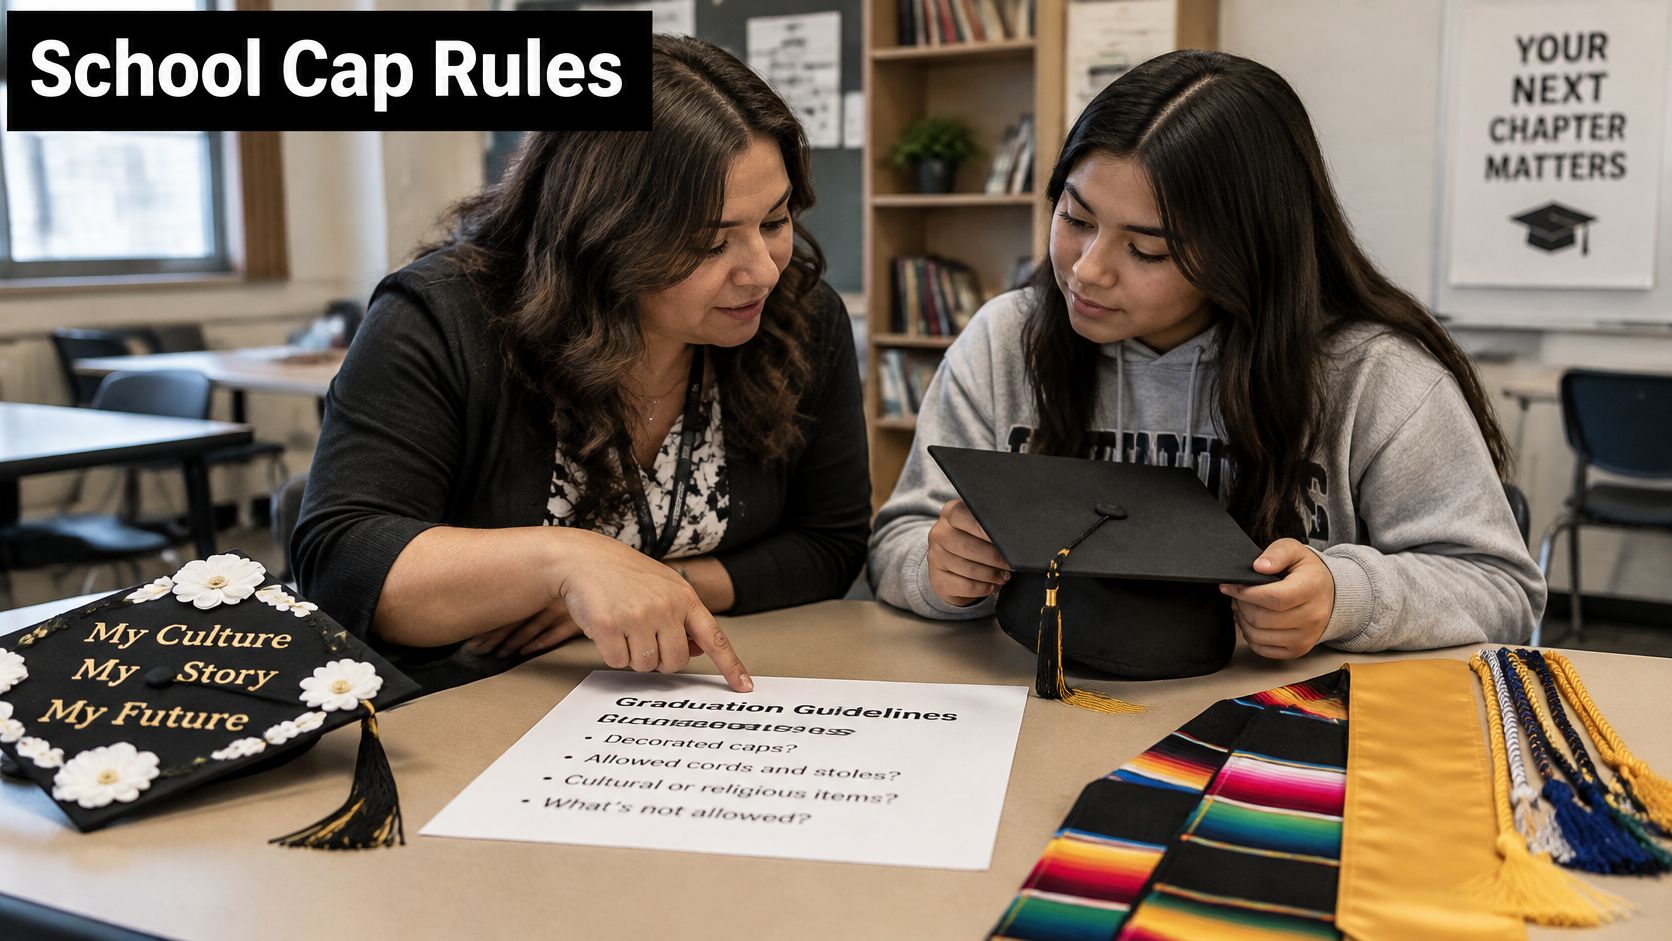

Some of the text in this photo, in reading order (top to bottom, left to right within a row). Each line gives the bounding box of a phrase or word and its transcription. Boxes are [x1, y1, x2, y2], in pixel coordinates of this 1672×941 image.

[1516, 32, 1608, 64] YOUR
[1511, 71, 1608, 105] NEXT
[1489, 112, 1627, 144] CHAPTER
[1485, 151, 1627, 182] MATTERS
[83, 622, 292, 650] My Culture
[71, 658, 280, 692] My Story
[37, 699, 249, 732] My Future
[615, 697, 958, 721] Graduation Guidelines
[602, 734, 798, 754] Decorated caps?
[584, 754, 902, 781] Allowed cords and stoles?
[564, 774, 899, 804] Cultural or religious items?
[543, 797, 812, 825] What's not allowed?
